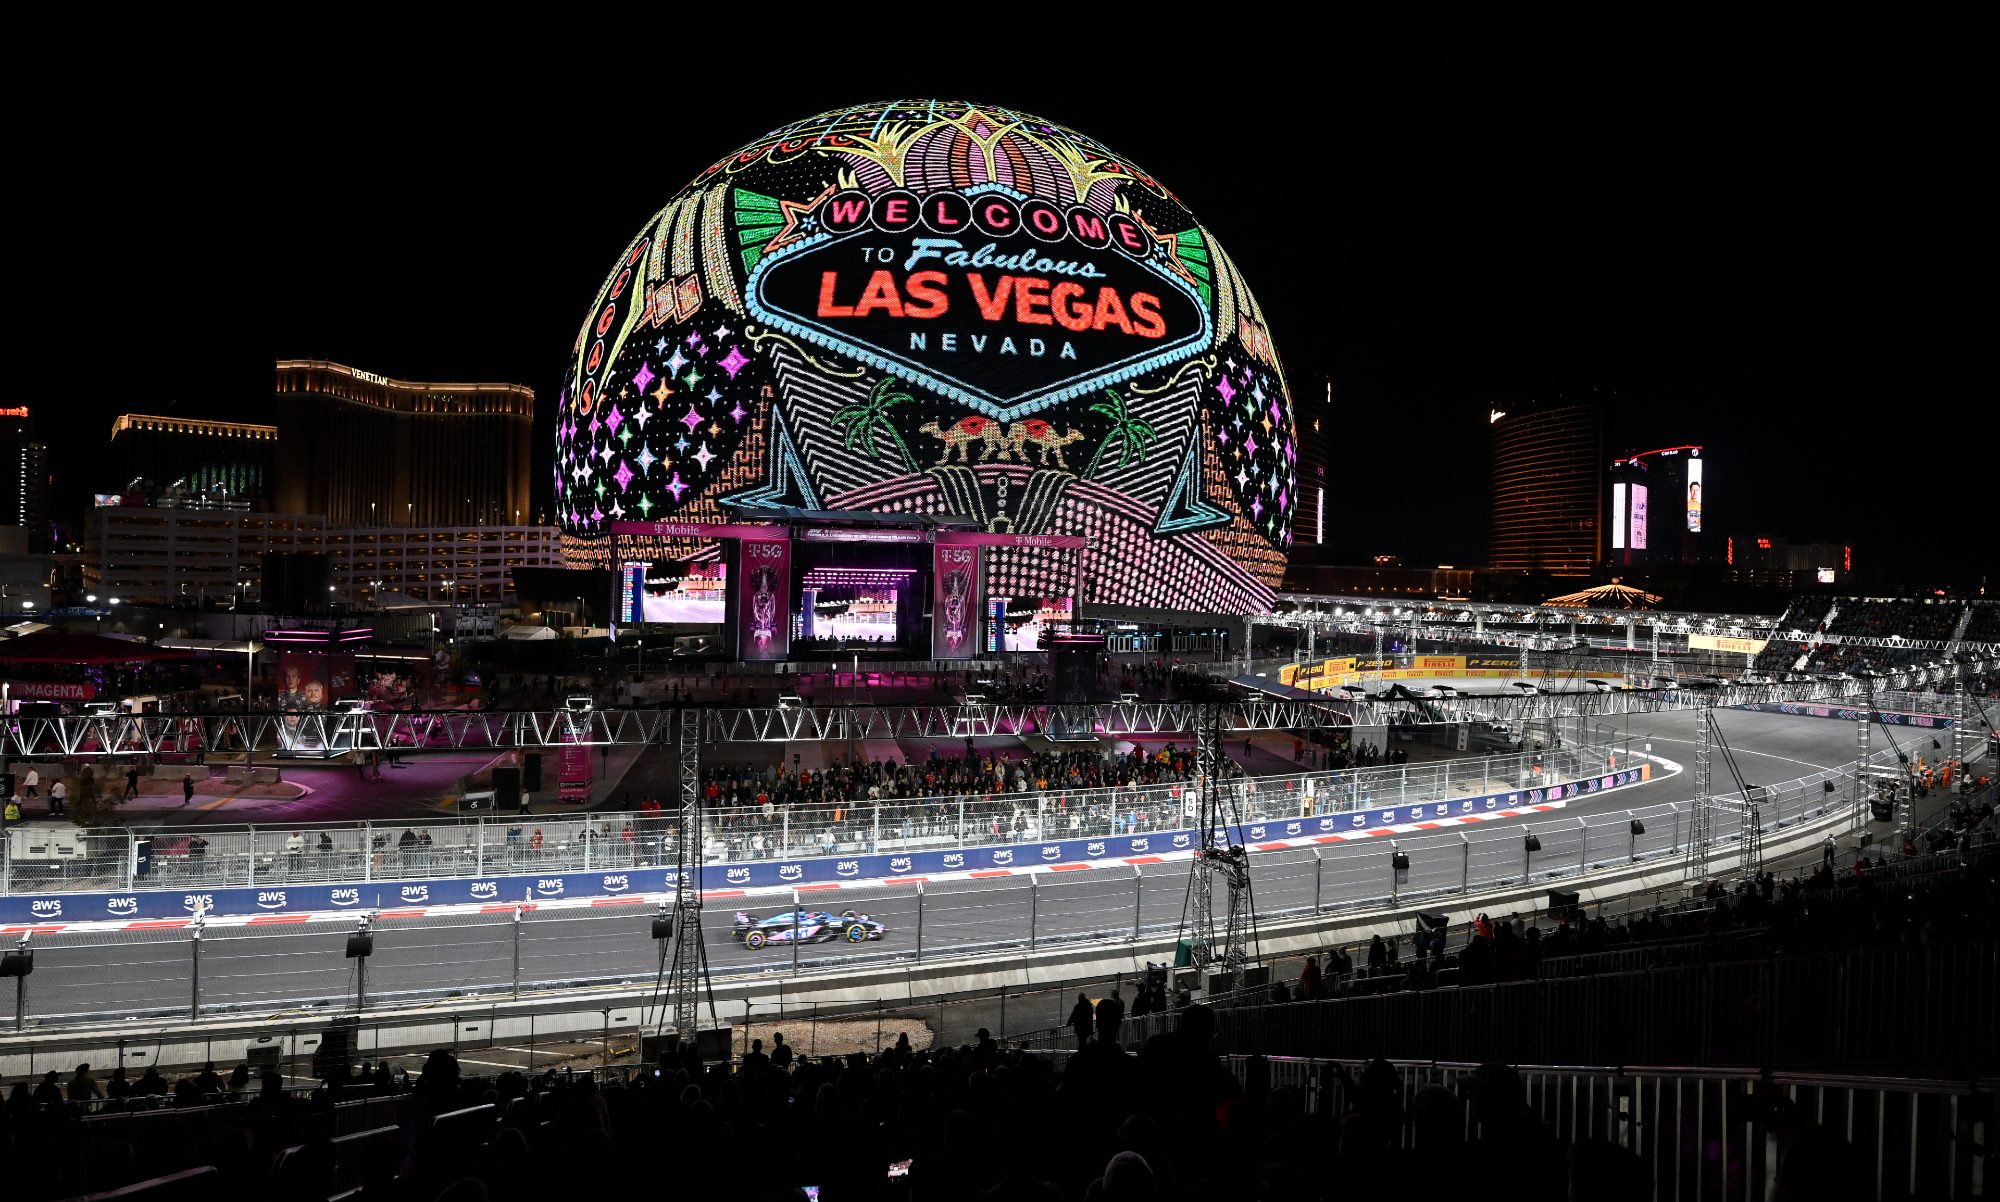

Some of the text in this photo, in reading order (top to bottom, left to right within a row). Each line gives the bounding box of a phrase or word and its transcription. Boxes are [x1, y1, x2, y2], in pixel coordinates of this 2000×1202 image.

[831, 199, 1142, 249] WELCOME
[862, 238, 1106, 279] TO Fabulous
[817, 269, 1166, 339] LAS VEGAS
[910, 332, 1078, 360] NEVADA
[351, 367, 389, 386] VENETIAN
[666, 525, 700, 535] Mobile
[1024, 537, 1053, 547] Mobile
[762, 544, 783, 558] 5G
[1424, 658, 1455, 667] PIRELLI
[1481, 659, 1520, 667] ZERO
[25, 684, 85, 698] MAGENTA
[1131, 837, 1148, 849] aws
[1174, 833, 1189, 844] aws
[1042, 845, 1060, 856] aws
[1088, 841, 1106, 852] aws
[944, 853, 963, 864] aws
[994, 849, 1012, 860] aws
[837, 860, 859, 873] aws
[891, 856, 911, 868] aws
[727, 867, 750, 880] aws
[780, 864, 801, 876] aws
[538, 878, 563, 891] aws
[604, 874, 628, 887] aws
[402, 885, 427, 898] aws
[471, 881, 496, 894] aws
[185, 894, 213, 907] aws
[258, 891, 286, 904] aws
[331, 888, 358, 901] aws
[32, 899, 61, 912] aws
[108, 897, 136, 910] aws
